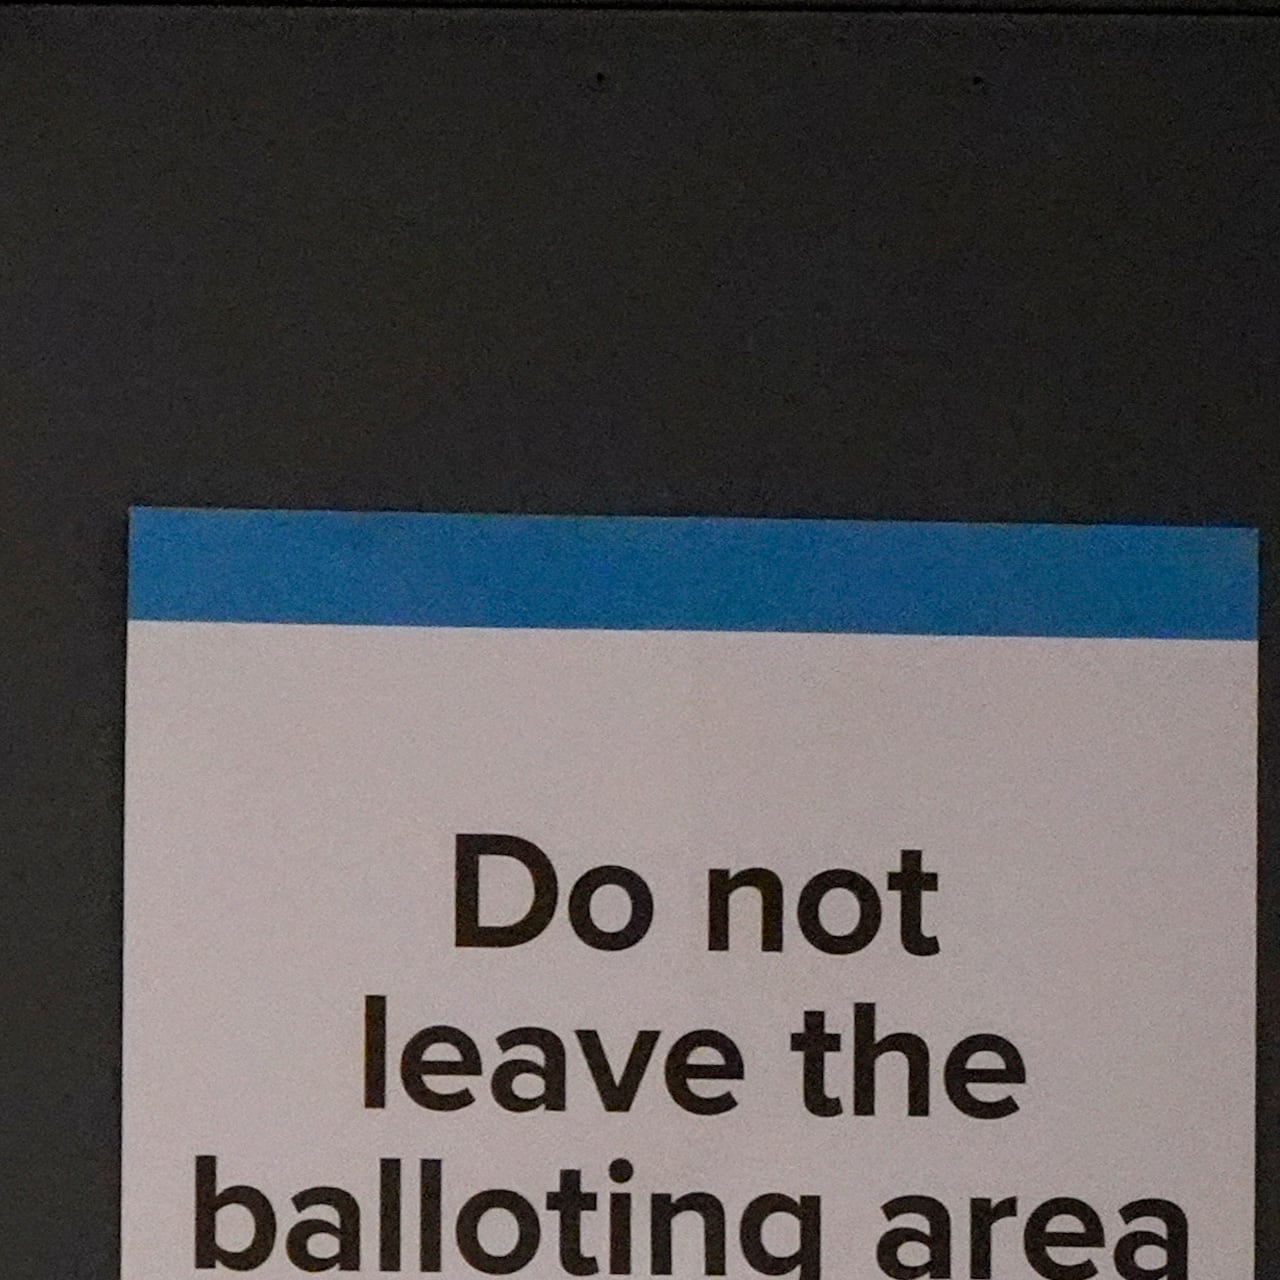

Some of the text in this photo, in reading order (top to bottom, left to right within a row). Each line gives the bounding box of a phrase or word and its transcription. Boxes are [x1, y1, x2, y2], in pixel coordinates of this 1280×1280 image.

[454, 833, 942, 958] Do not
[363, 993, 1028, 1120] leave the
